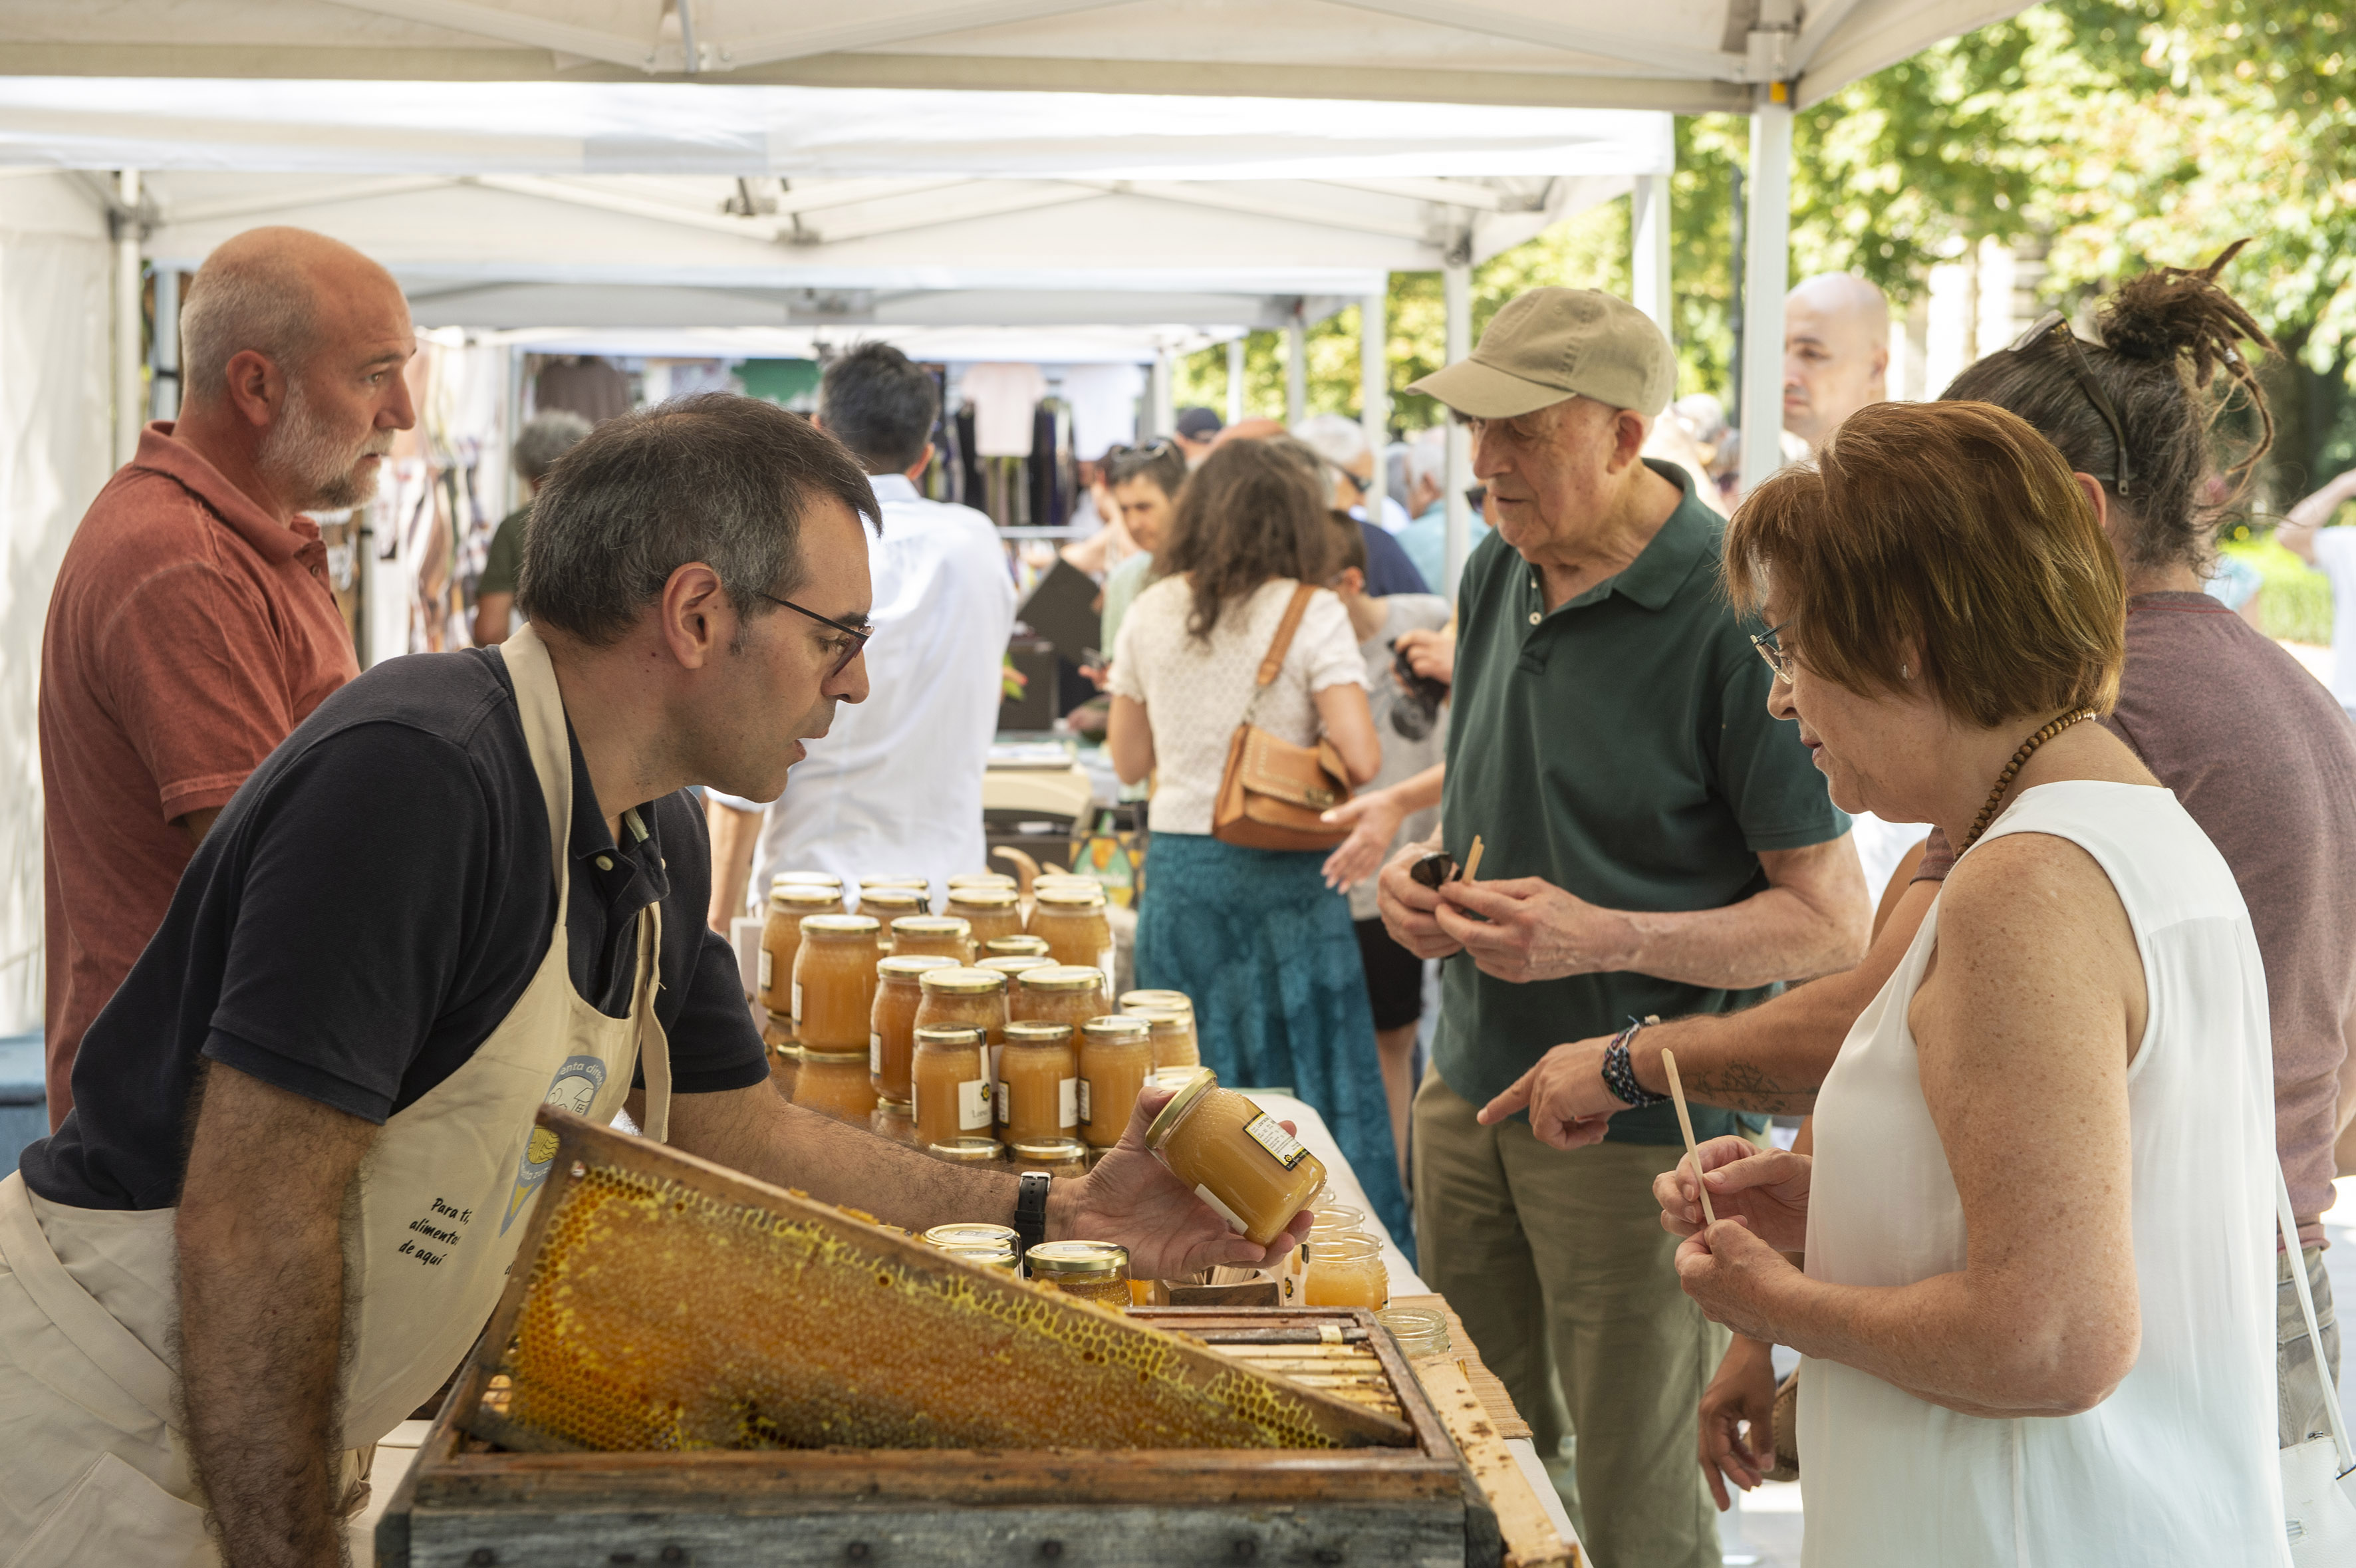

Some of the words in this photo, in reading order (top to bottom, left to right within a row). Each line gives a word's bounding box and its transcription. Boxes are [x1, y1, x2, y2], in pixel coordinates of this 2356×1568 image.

[431, 1198, 459, 1219] Para
[459, 1208, 473, 1226] ti,
[398, 1240, 416, 1255] de
[414, 1248, 448, 1266] aquí
